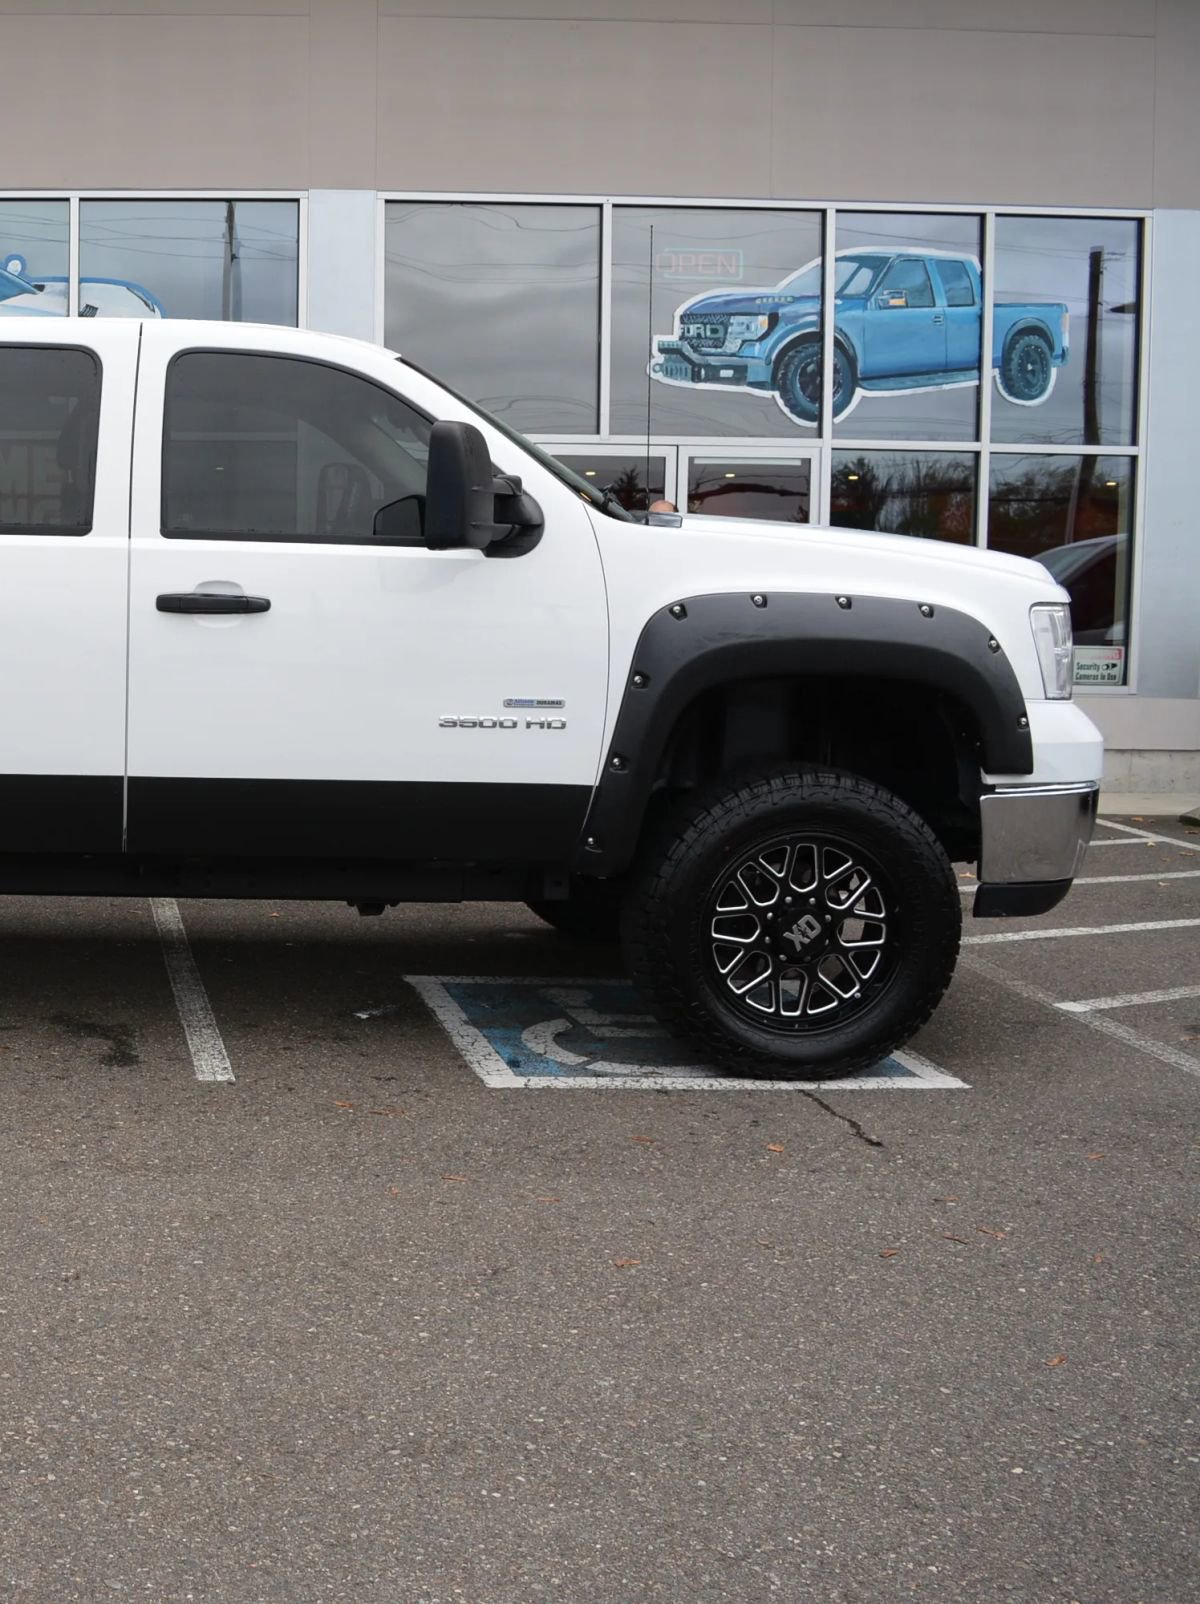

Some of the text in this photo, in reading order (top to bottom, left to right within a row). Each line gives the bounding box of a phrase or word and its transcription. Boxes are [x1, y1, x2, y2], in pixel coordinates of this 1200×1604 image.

[656, 253, 737, 274] OPEN
[1076, 662, 1100, 672] Security
[1075, 672, 1099, 681] Cameras
[439, 715, 567, 730] 3500 HD
